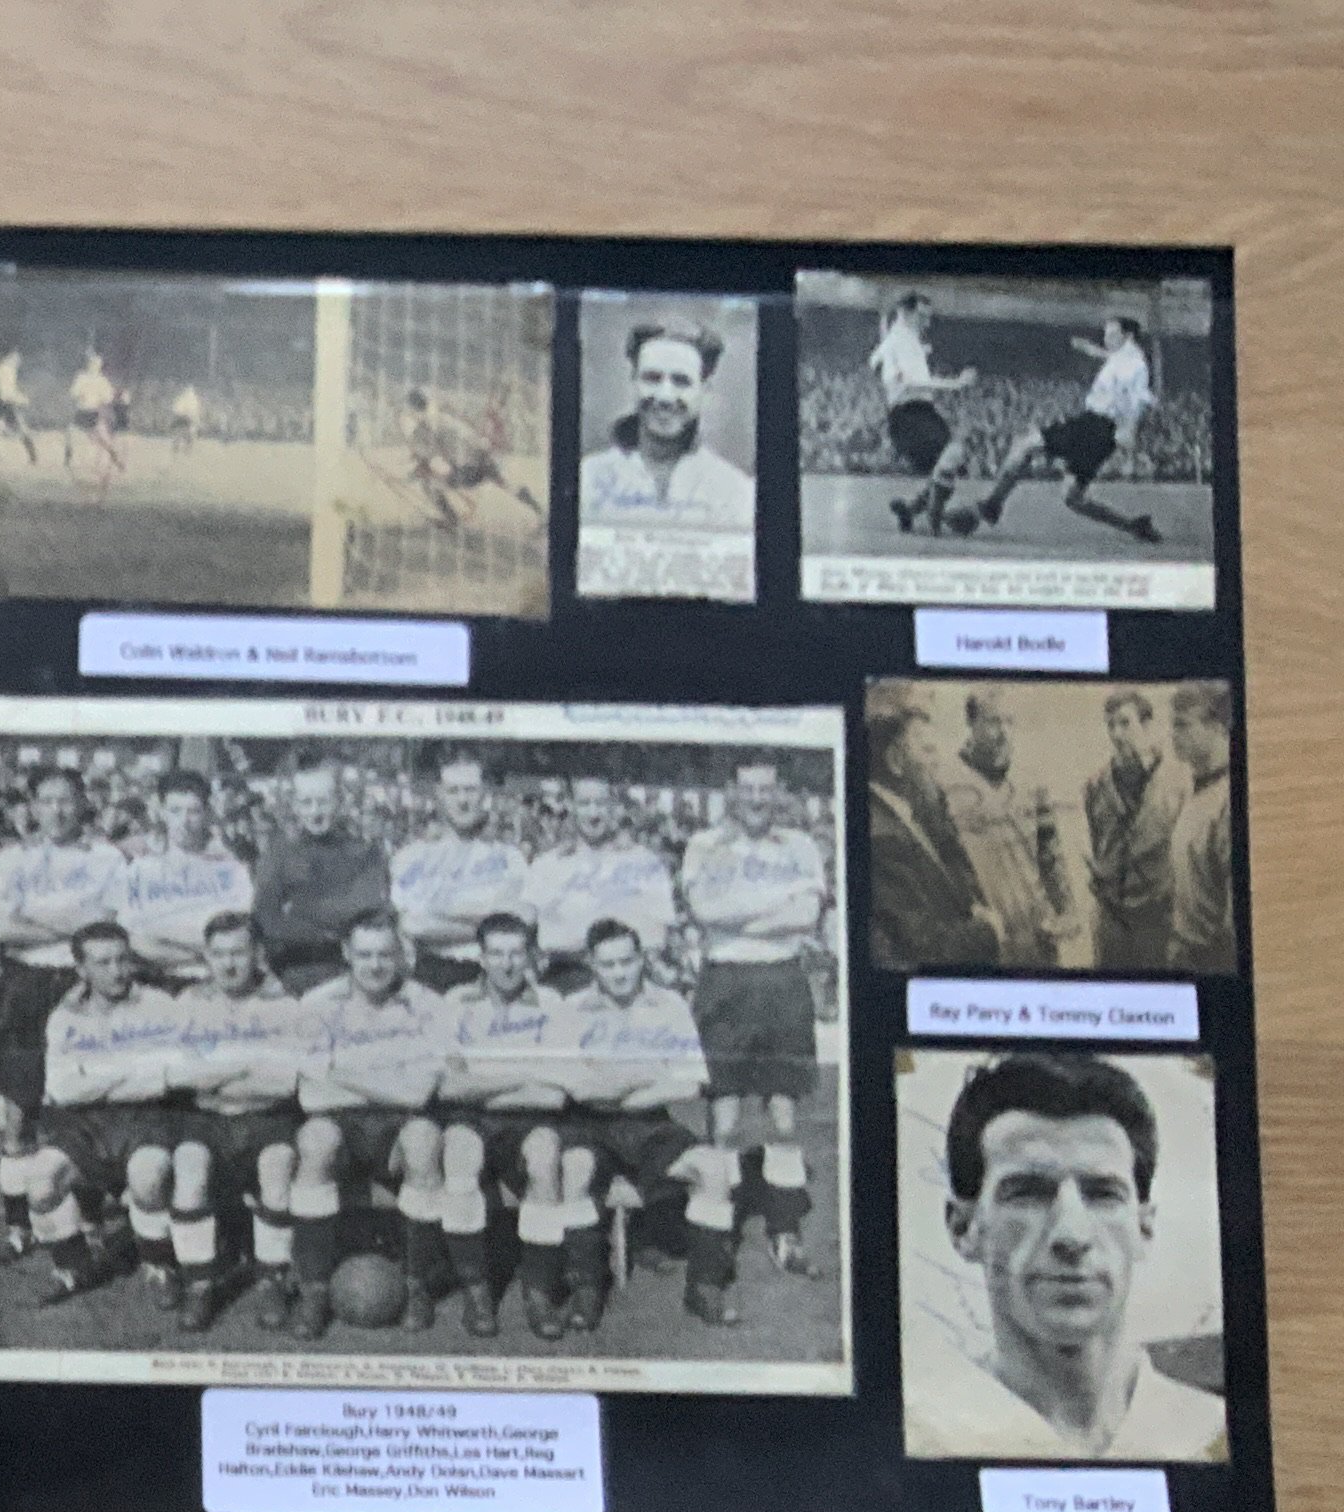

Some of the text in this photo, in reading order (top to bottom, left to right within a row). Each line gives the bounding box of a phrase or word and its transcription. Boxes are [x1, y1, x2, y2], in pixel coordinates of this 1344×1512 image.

[928, 1002, 1176, 1026] Ray Parry & Tommy Claxton
[341, 1403, 378, 1422] Bury
[244, 1422, 281, 1441] Cyril
[311, 1482, 342, 1499] Eric
[445, 1484, 497, 1500] Wilson
